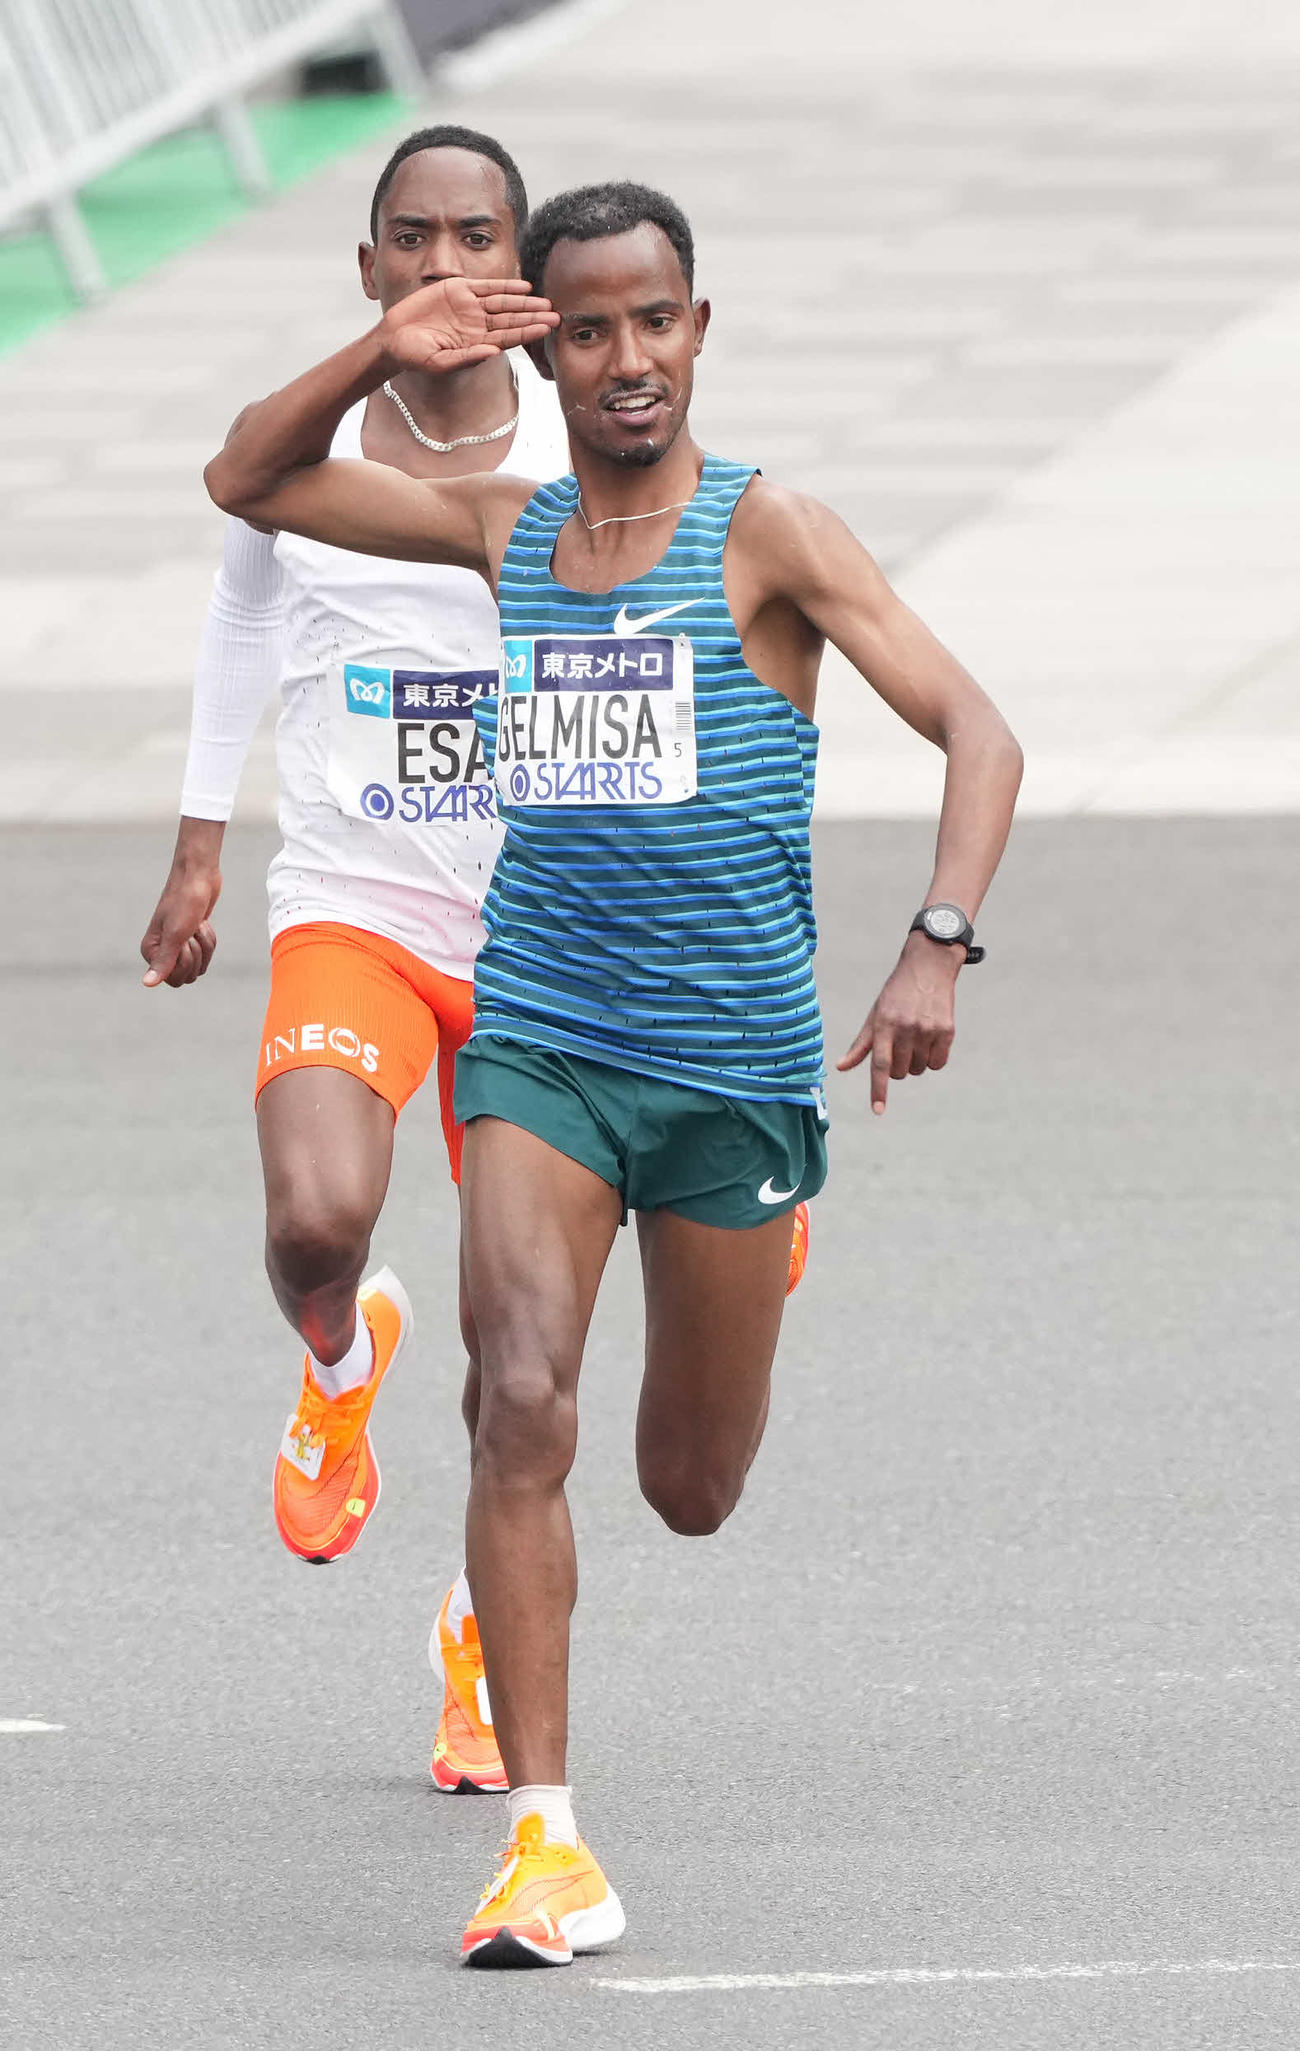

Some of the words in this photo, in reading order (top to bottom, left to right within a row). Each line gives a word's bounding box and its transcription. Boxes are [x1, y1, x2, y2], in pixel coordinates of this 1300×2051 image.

[541, 652, 663, 680] 東京メトロ
[498, 693, 663, 762] GELMISA
[674, 742, 682, 758] 5
[397, 722, 492, 784] ESA
[265, 1024, 380, 1073] INEOS
